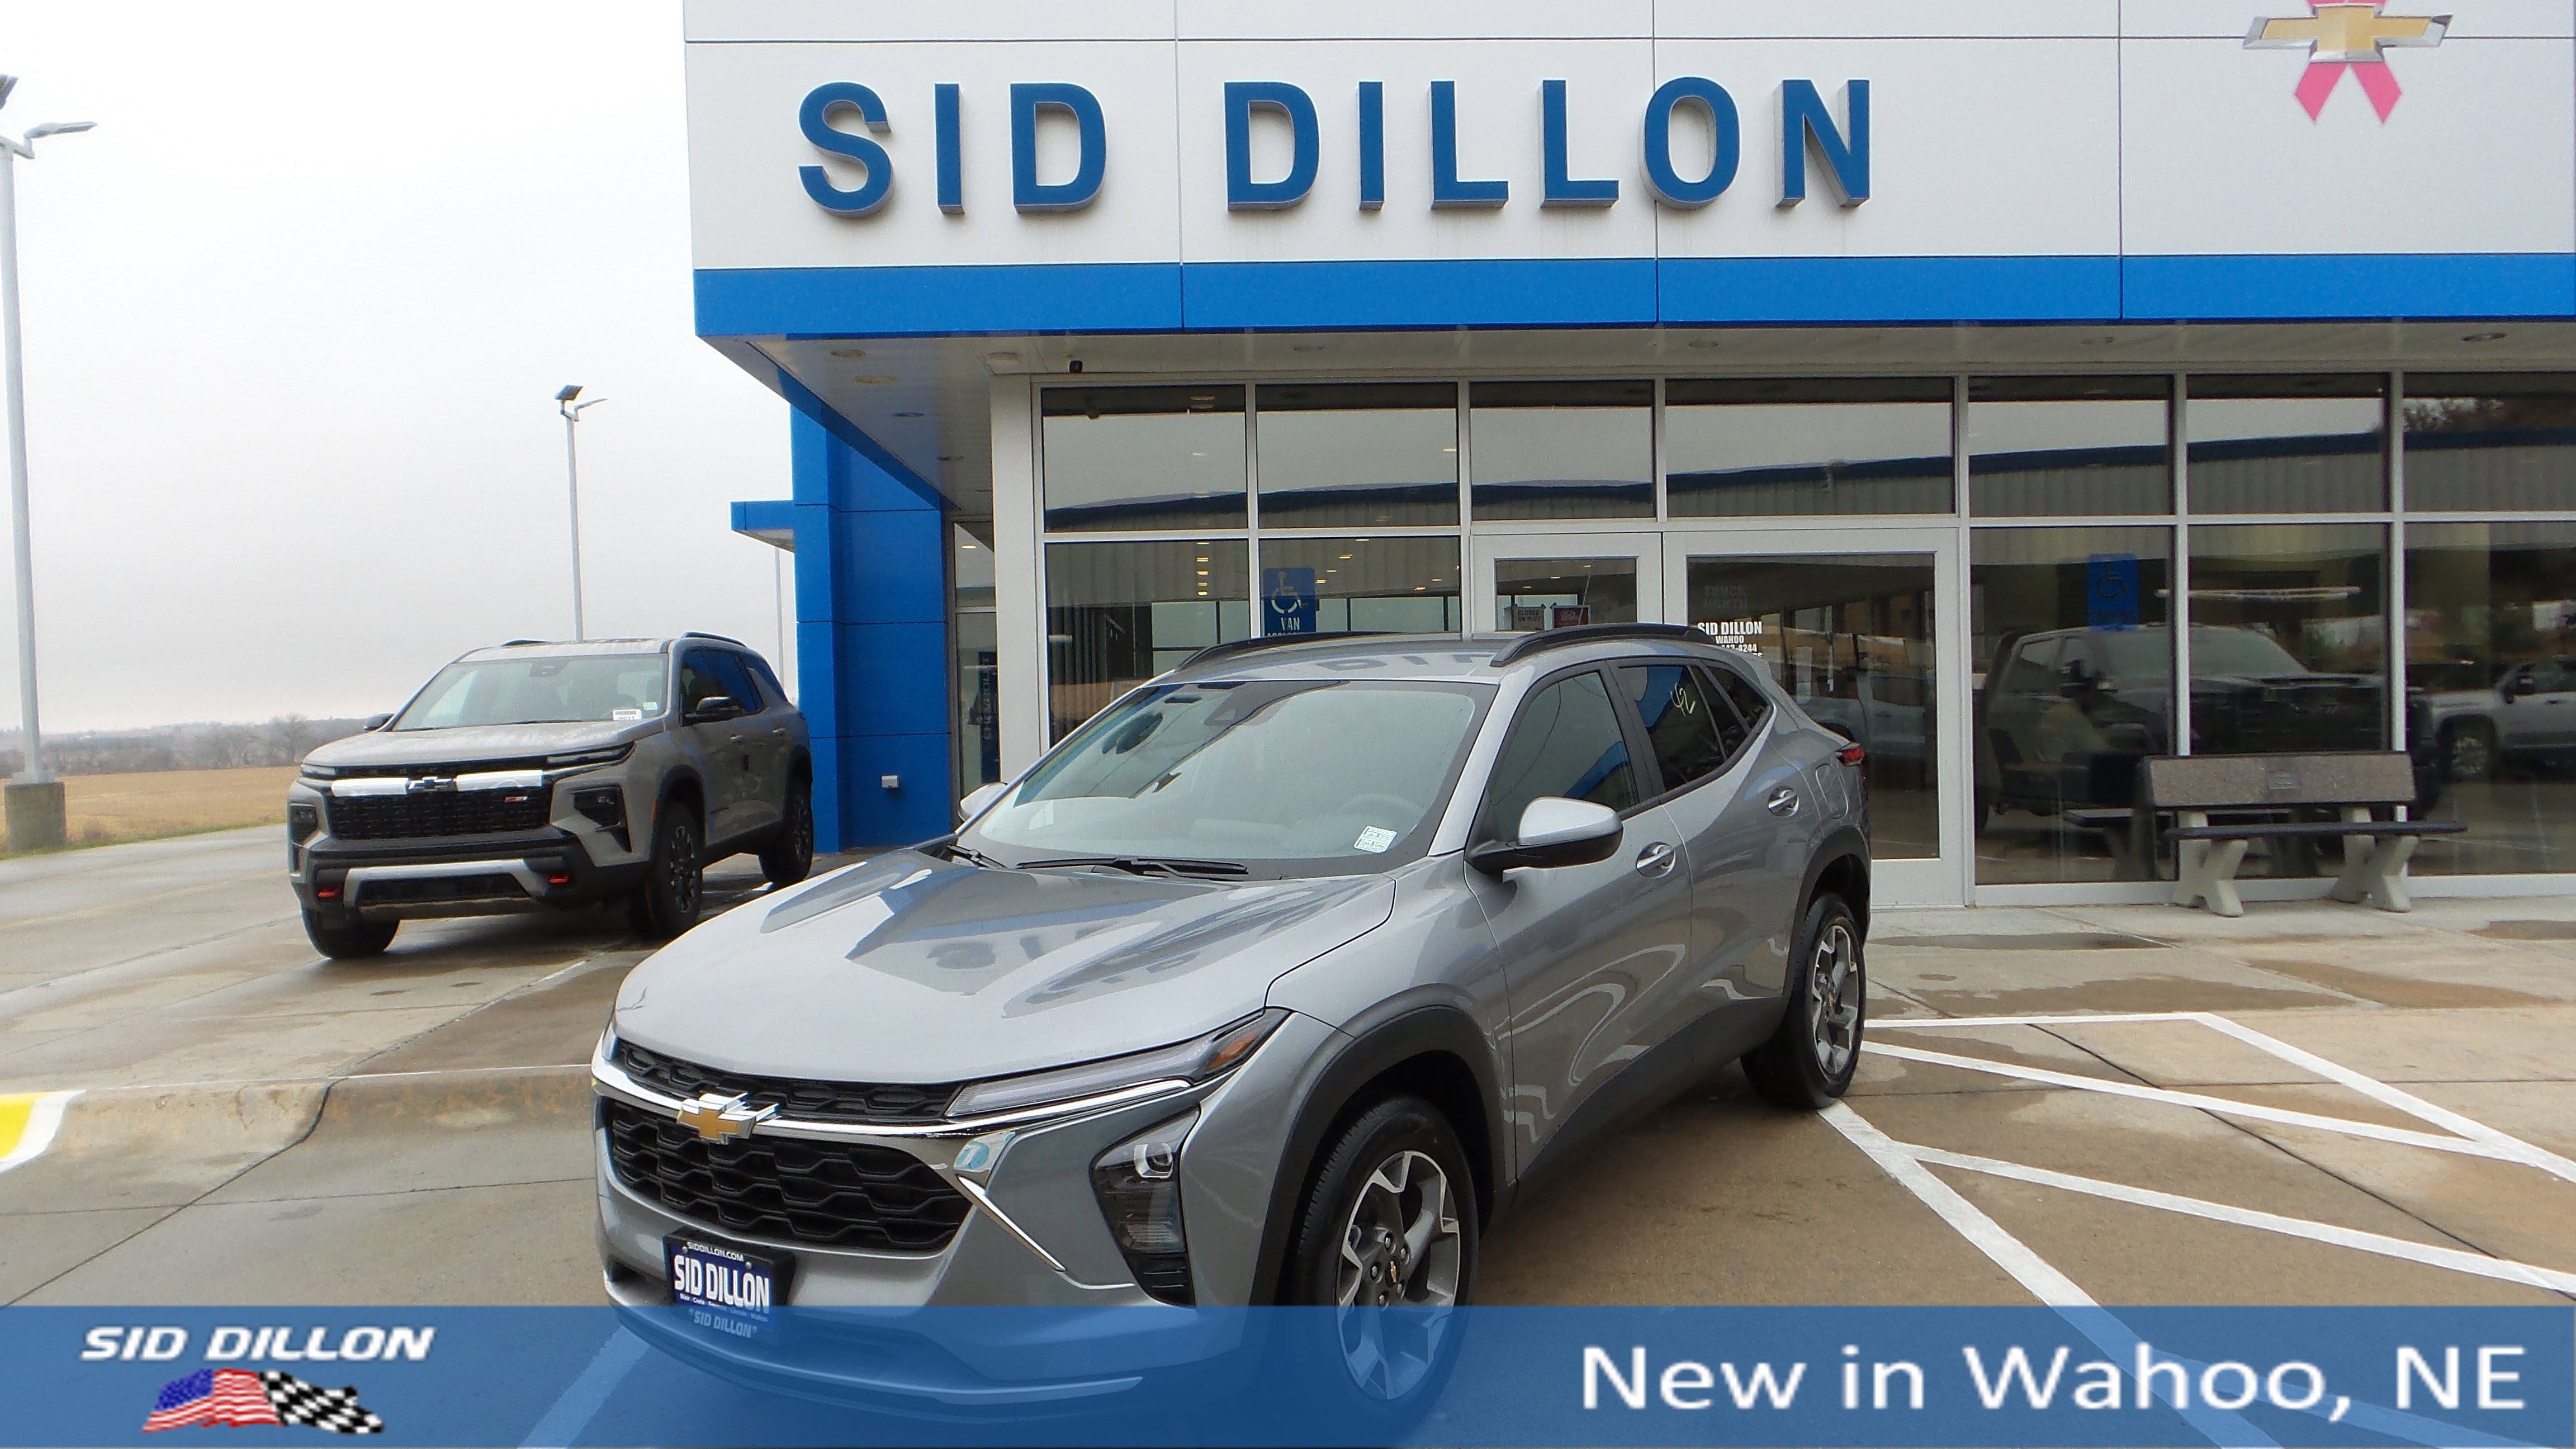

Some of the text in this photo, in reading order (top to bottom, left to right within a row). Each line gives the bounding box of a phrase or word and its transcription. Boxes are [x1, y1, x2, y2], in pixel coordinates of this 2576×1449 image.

[798, 76, 1872, 215] SID DILLON
[1281, 617, 1300, 631] VAN
[1698, 621, 1763, 635] SID DILLON
[1715, 635, 1745, 644] WAHOO
[1721, 643, 1758, 652] 3-4244
[1670, 683, 1696, 717] 42
[687, 1241, 744, 1262] SIDDILLON.COM
[674, 1254, 770, 1314] SID DILLON
[693, 1310, 751, 1338] SID DILLON
